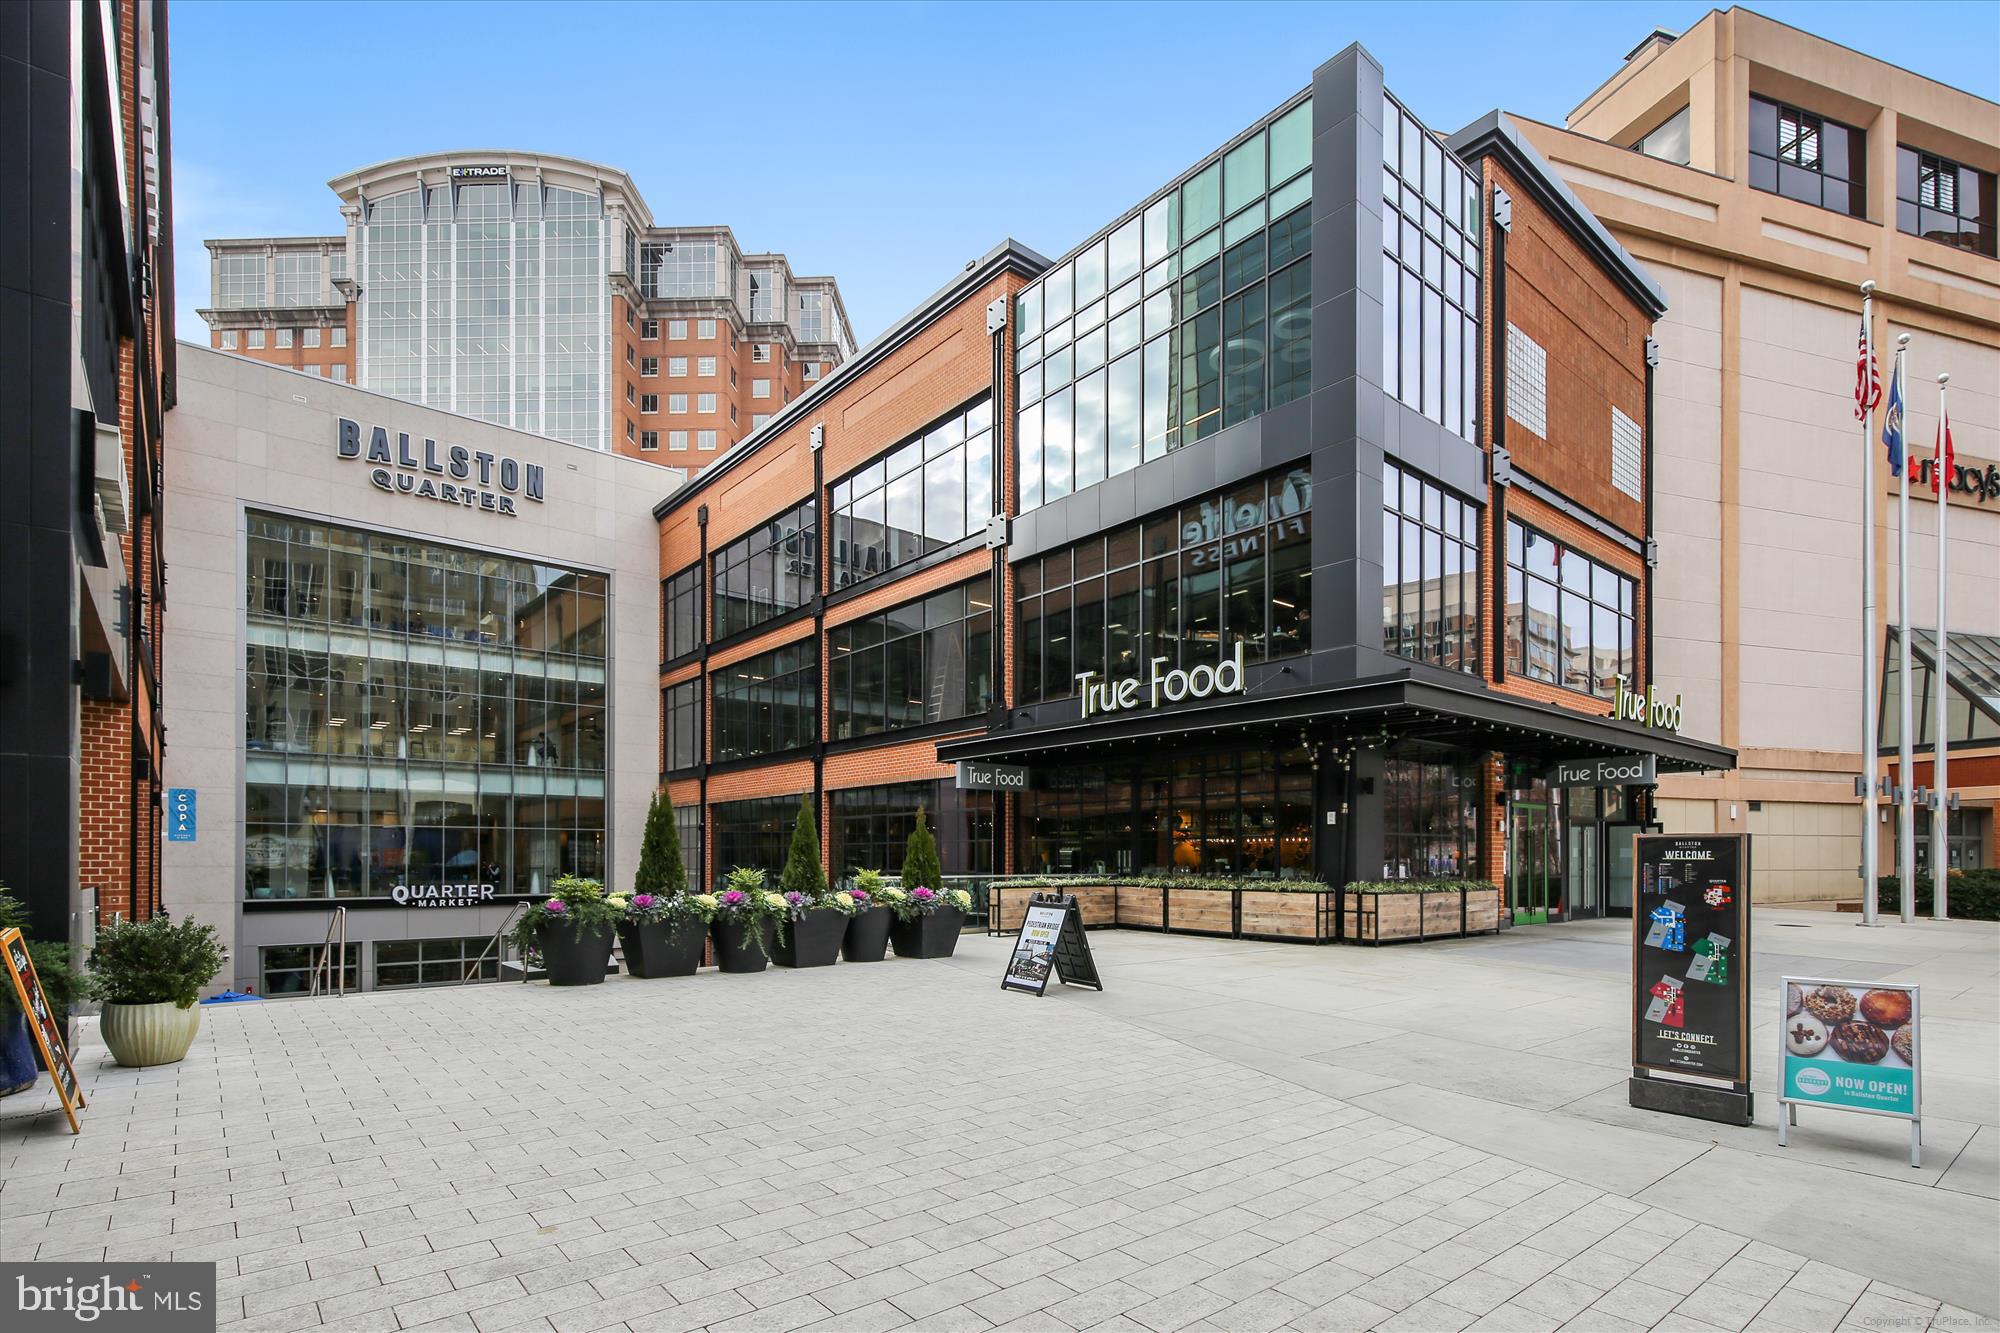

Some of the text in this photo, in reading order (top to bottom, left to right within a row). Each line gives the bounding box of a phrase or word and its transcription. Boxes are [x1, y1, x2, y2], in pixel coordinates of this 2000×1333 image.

[337, 416, 545, 503] BALLSTON
[370, 467, 518, 516] QUARTER
[1075, 640, 1244, 719] True Food
[1613, 673, 1683, 734] True Food
[967, 766, 1025, 786] True Food
[1558, 760, 1643, 783] True Food
[177, 794, 188, 831] COPA
[1665, 850, 1712, 860] WELCOME
[392, 884, 494, 905] QUARTER
[418, 899, 473, 907] MARKET
[1660, 1029, 1714, 1044] LET'S CONNECT
[1835, 1076, 1864, 1090] NOW
[1869, 1080, 1907, 1096] OPEN!
